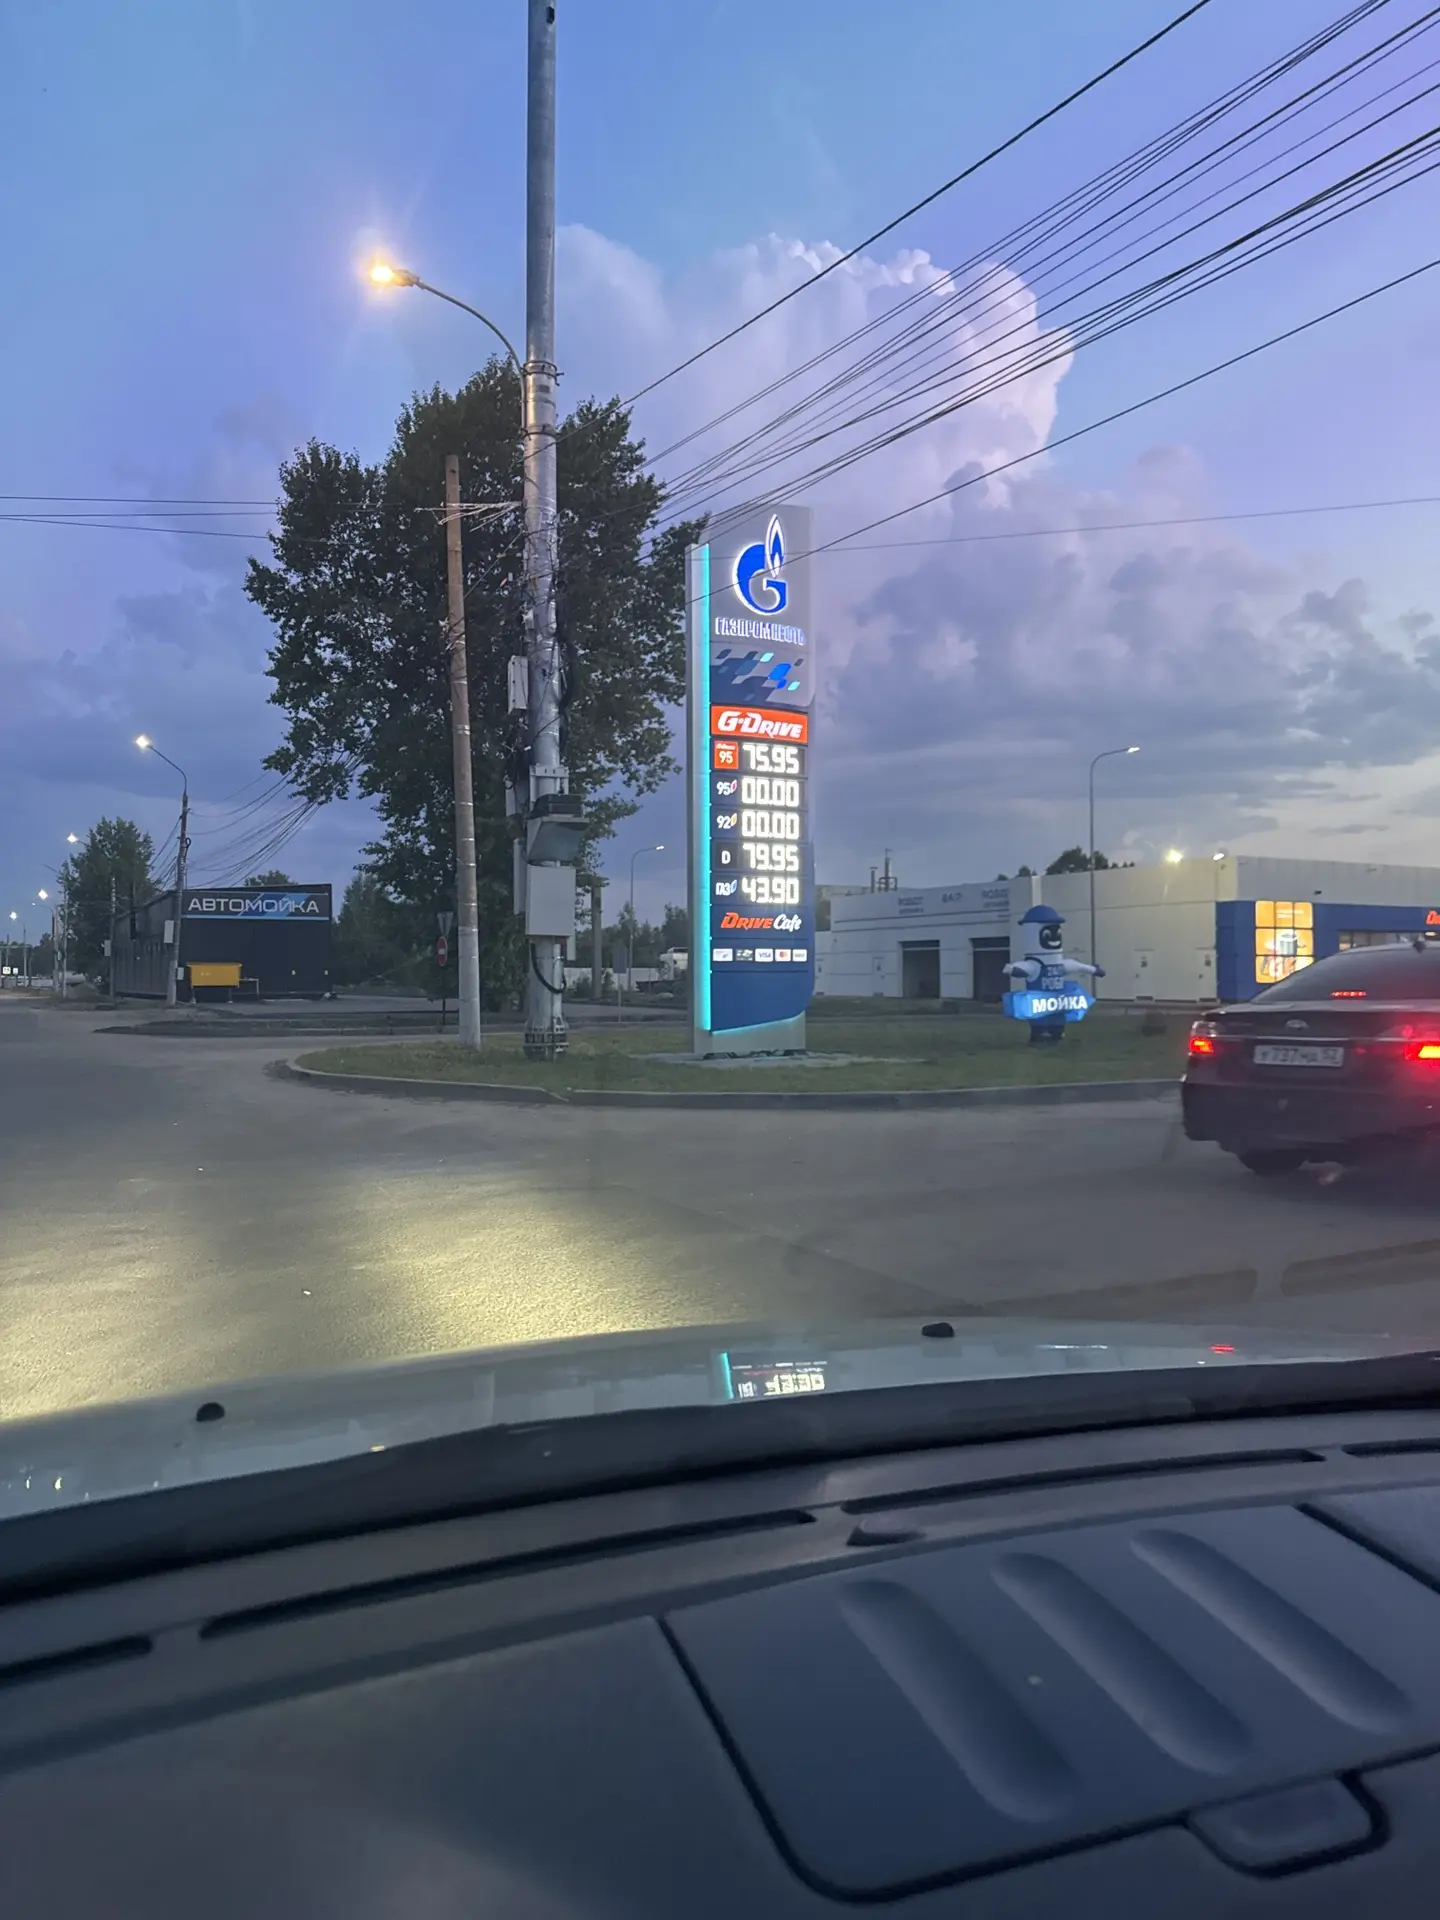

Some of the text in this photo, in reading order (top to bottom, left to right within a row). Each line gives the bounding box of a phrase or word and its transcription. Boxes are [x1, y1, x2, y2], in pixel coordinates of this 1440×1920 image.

[715, 616, 806, 646] ГАЗПРОМНЕФТЬ
[719, 744, 800, 774] 95 75.95
[716, 777, 800, 807] 95 00.00
[716, 809, 800, 840] 92 00.00
[721, 843, 799, 872] D 79.95
[715, 877, 799, 904] ГАЗ 43.90
[188, 897, 319, 914] АВТОМОЙКА
[721, 911, 774, 930] DRIVE
[1032, 995, 1088, 1014] МОЙКА
